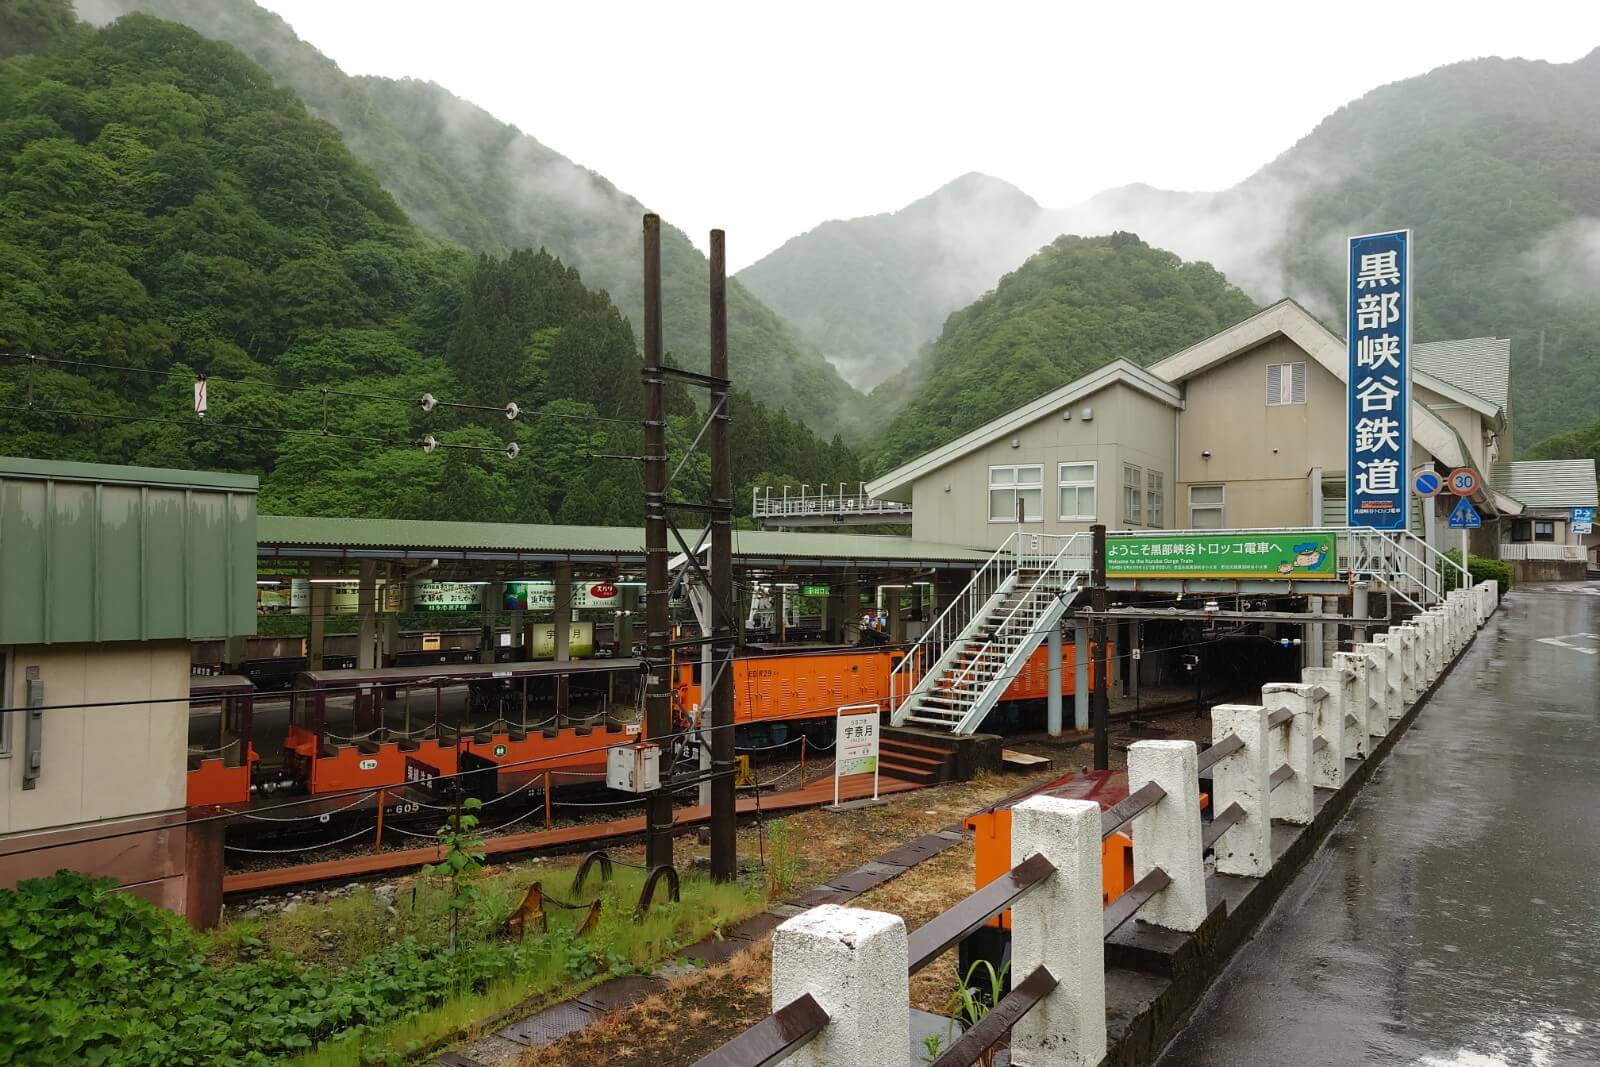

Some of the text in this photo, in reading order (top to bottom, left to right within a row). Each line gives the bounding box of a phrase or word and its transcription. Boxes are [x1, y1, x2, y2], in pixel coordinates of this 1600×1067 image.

[1355, 250, 1401, 496] 黒部峡谷鉄道
[1455, 475, 1473, 488] 30
[1574, 509, 1582, 517] P
[1108, 542, 1282, 556] ようこそ黒部峡谷トロッコ電車へ
[546, 630, 581, 640] 宇月
[844, 724, 873, 739] 宇奈月
[396, 803, 420, 814] 605
